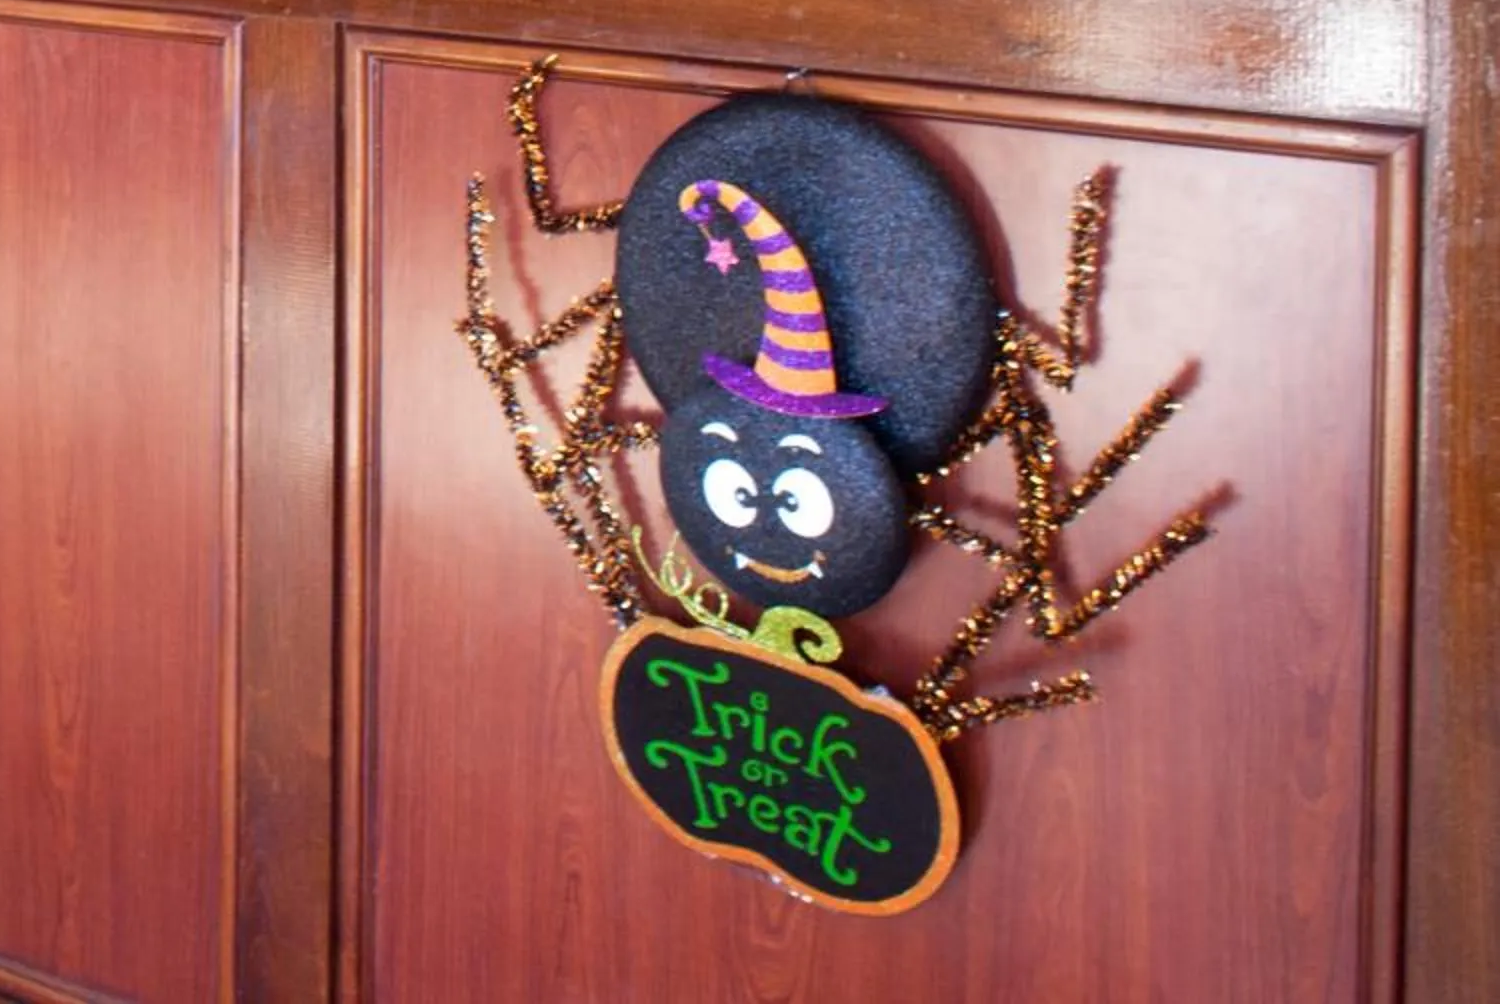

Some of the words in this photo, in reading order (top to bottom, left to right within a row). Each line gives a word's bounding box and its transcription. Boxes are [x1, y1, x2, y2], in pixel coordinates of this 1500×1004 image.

[645, 658, 867, 806] Trick
[739, 758, 789, 787] or
[643, 740, 893, 886] Treat
